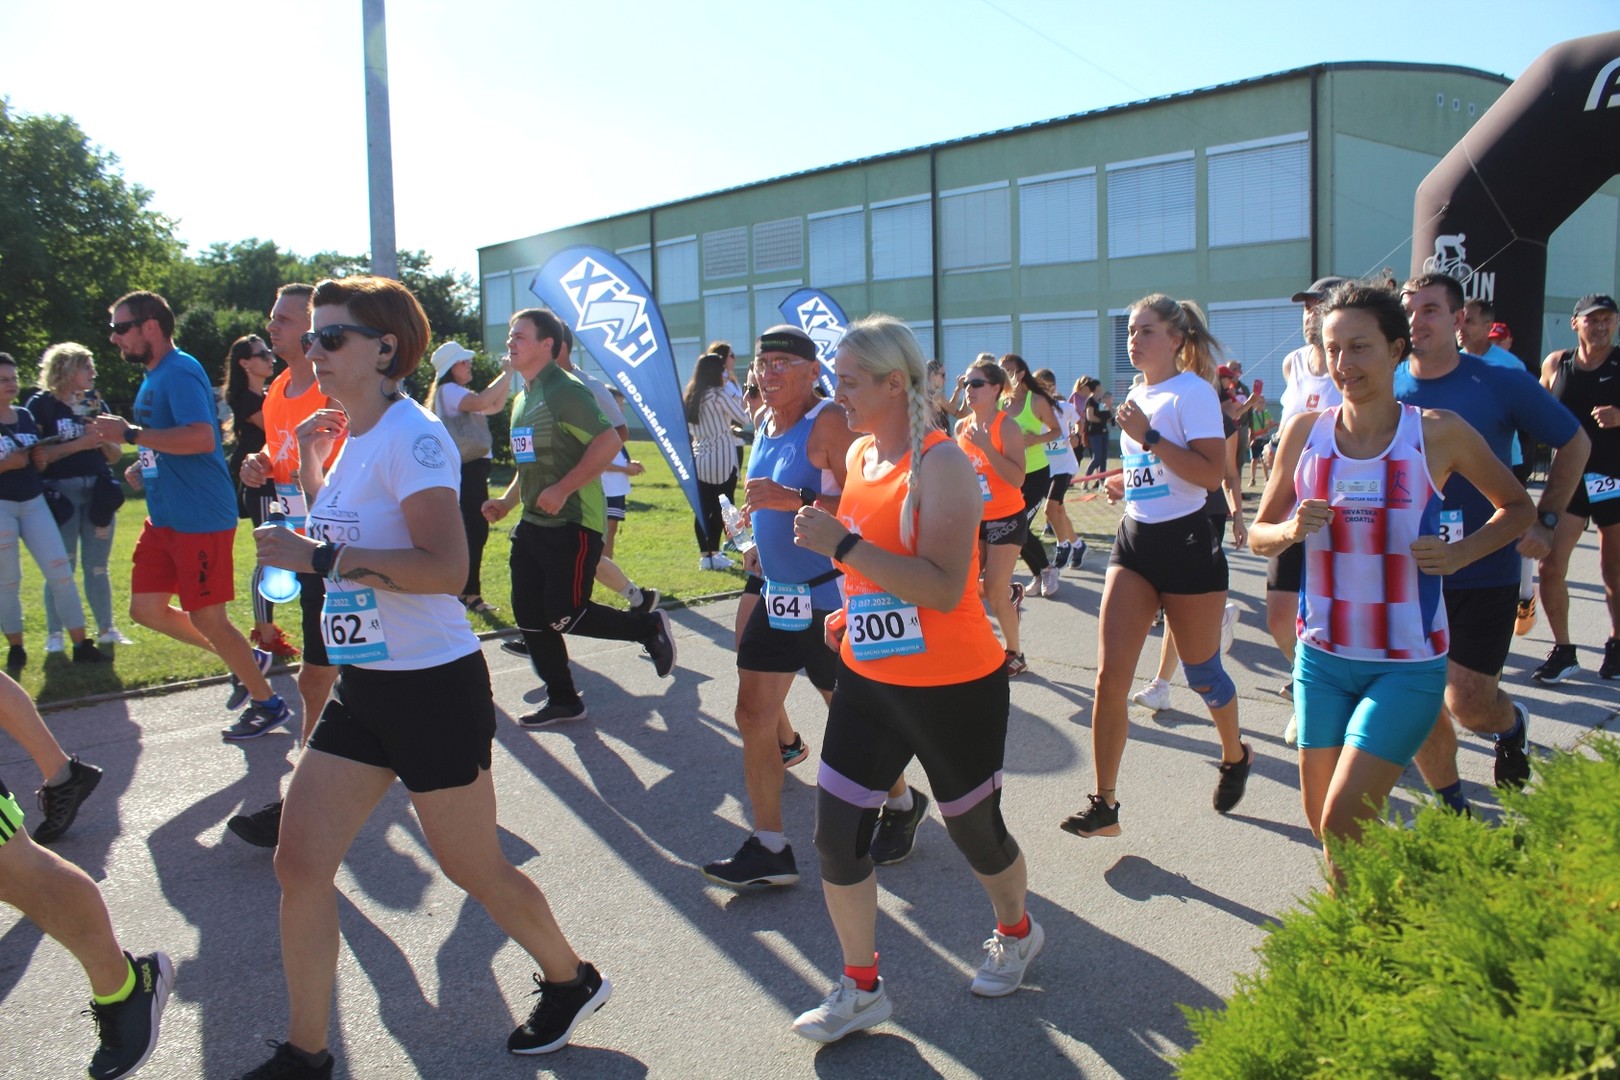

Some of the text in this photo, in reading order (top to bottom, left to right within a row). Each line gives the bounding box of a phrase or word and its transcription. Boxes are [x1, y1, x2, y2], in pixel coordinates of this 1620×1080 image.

[1127, 467, 1155, 488] 264
[1594, 477, 1616, 493] 29
[854, 611, 905, 643] 300
[141, 962, 153, 993] HOKA
